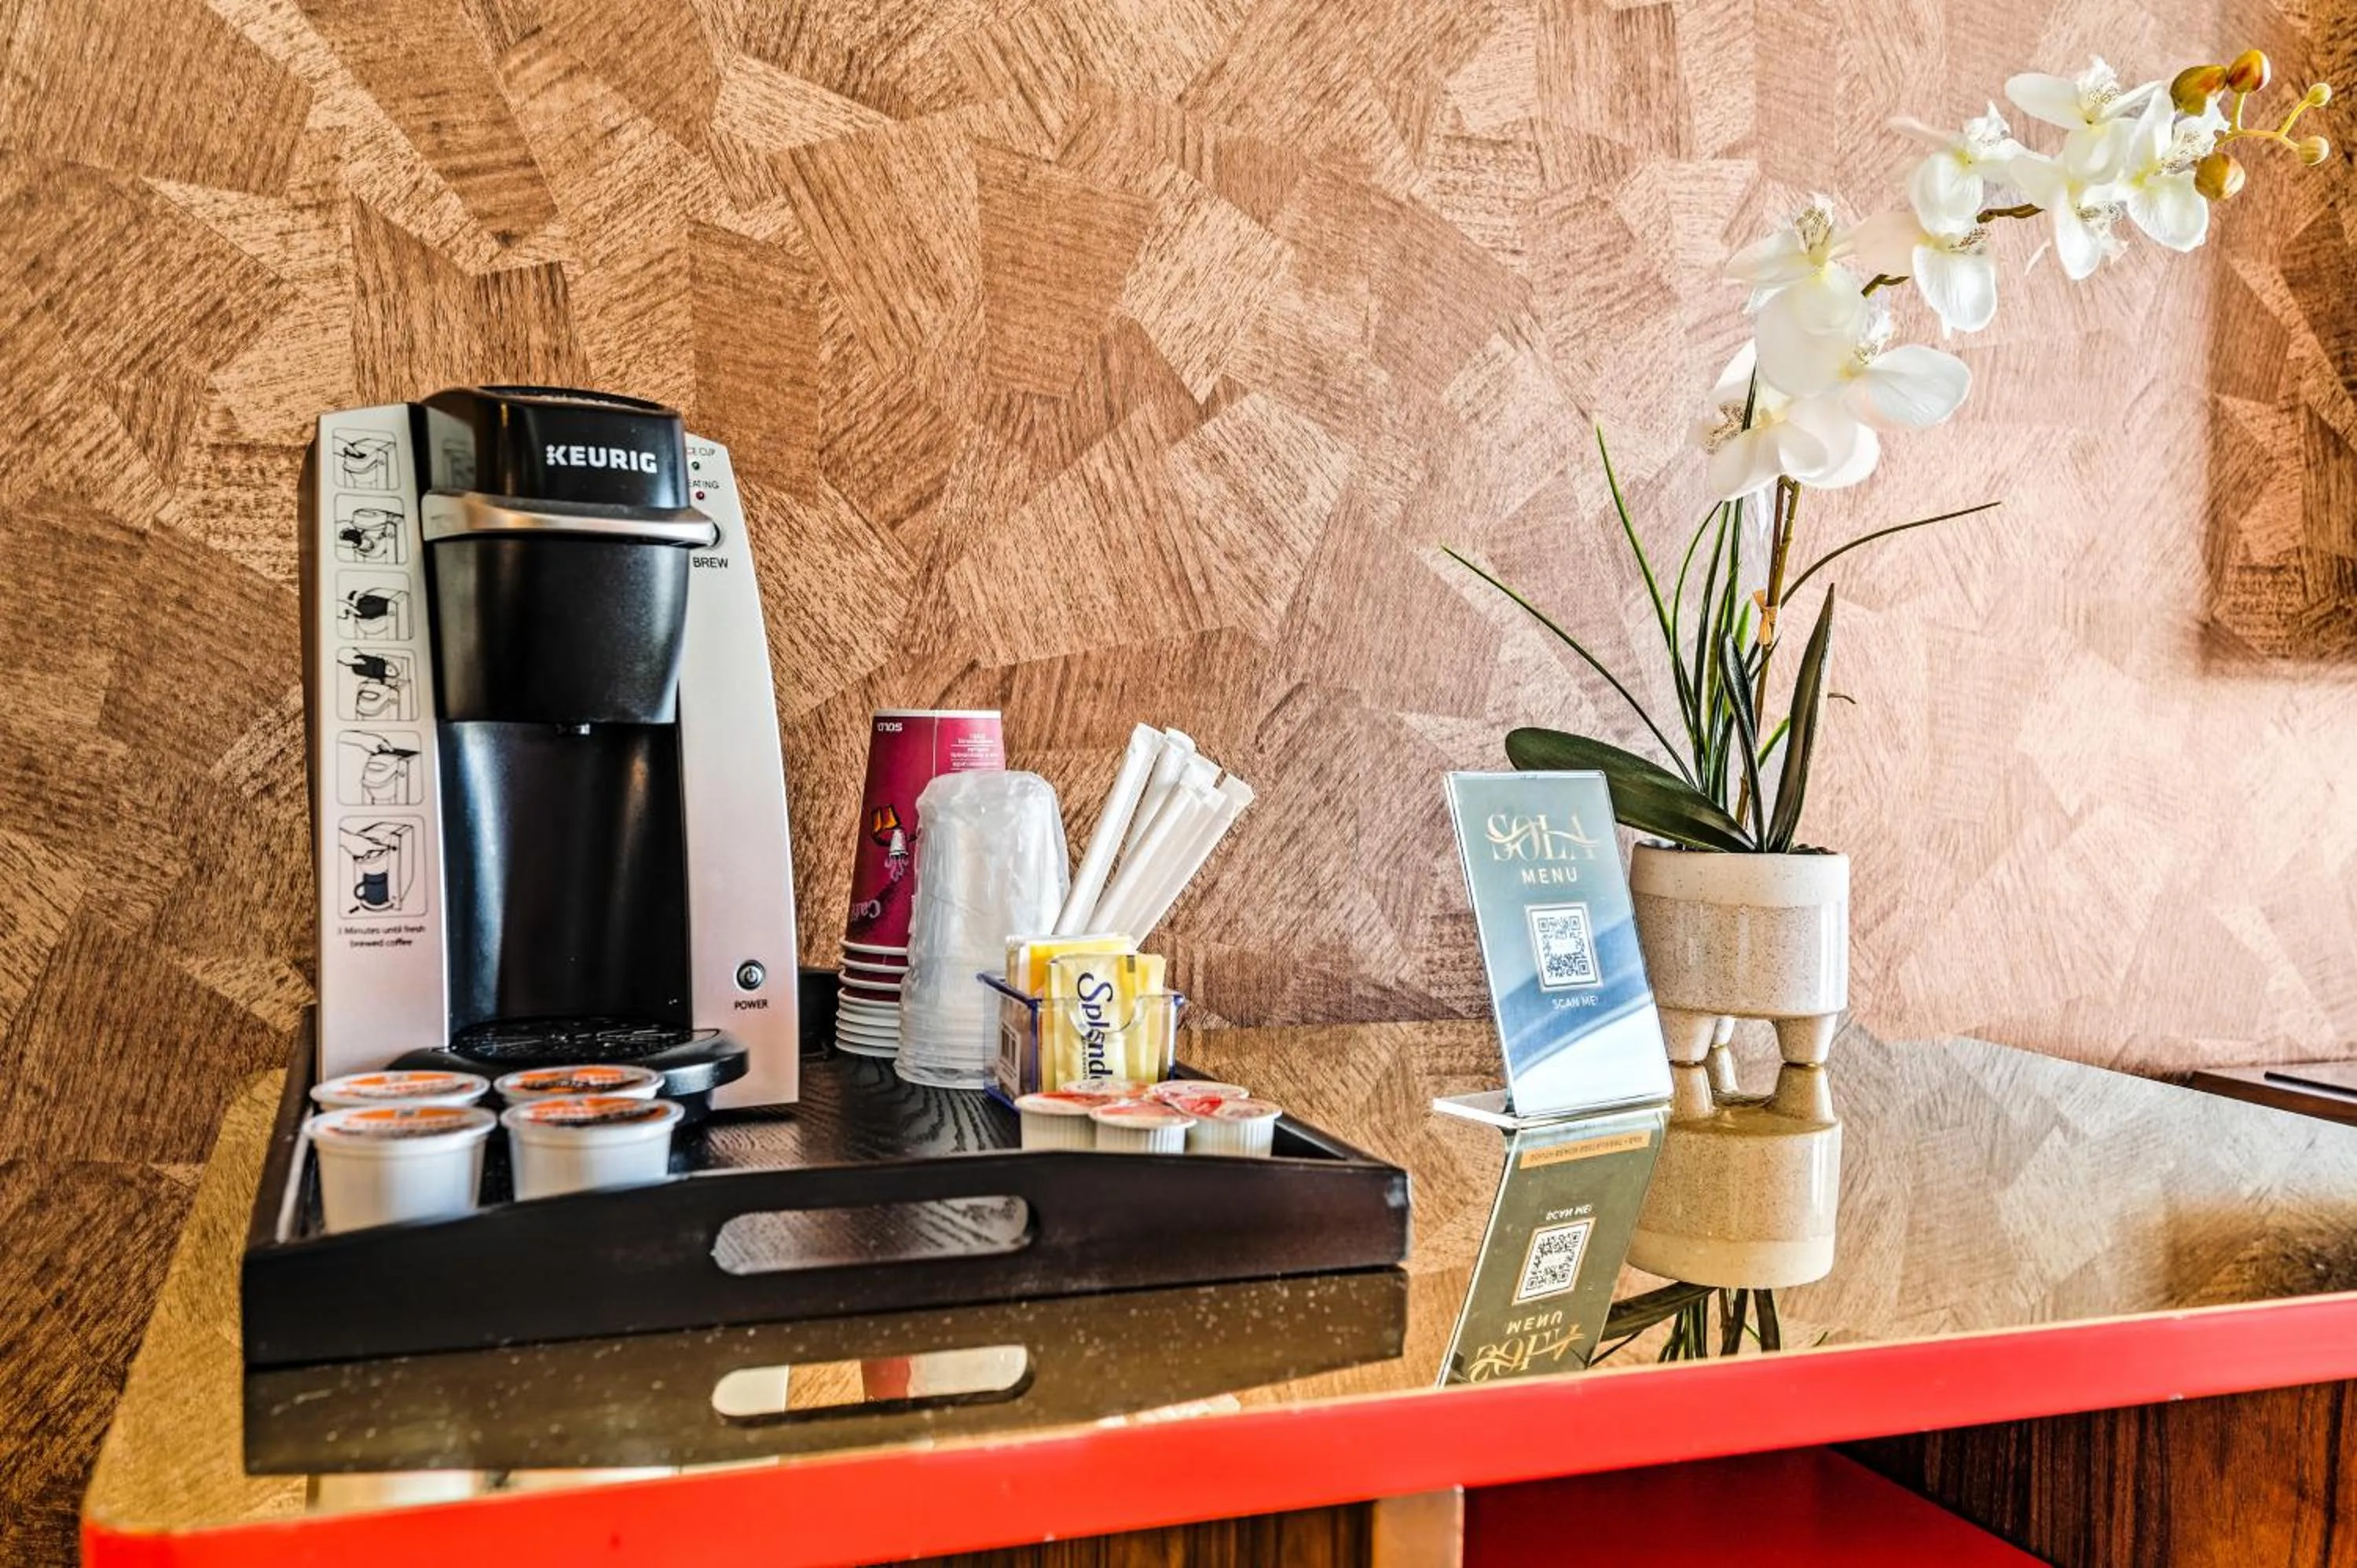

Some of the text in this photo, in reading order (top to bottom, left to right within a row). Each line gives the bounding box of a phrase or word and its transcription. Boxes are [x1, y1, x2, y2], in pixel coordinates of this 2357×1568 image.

[546, 445, 658, 474] KEURIG
[687, 478, 720, 489] EATING
[692, 556, 729, 569] BREW
[1486, 813, 1600, 863] SOLA
[1522, 866, 1578, 885] MENU
[344, 926, 379, 935] Minutes
[382, 925, 402, 935] until
[350, 937, 412, 948] brewed coffee
[734, 999, 768, 1010] POWER
[1552, 996, 1580, 1010] SCAN
